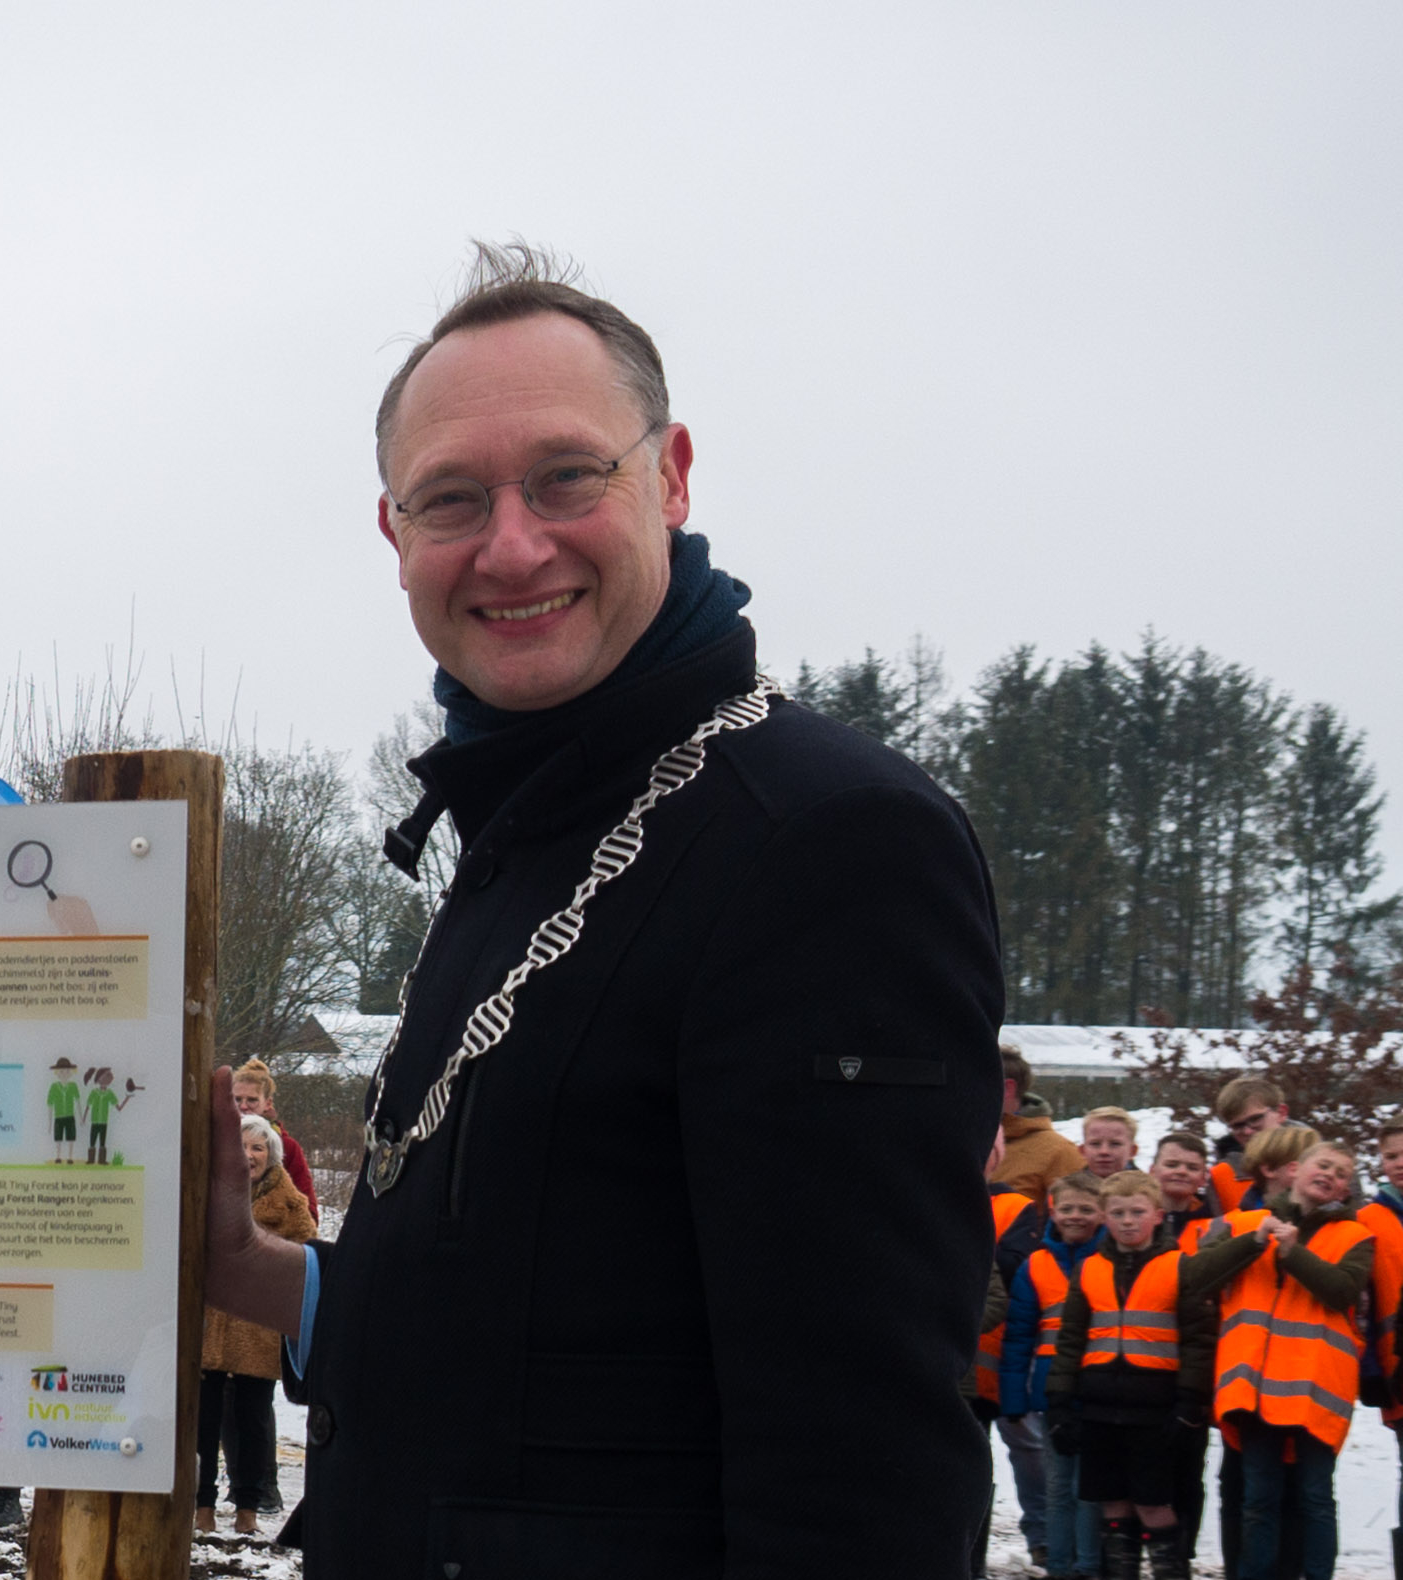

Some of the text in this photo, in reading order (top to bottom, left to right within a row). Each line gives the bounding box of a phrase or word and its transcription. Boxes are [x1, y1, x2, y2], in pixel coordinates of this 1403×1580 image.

[6, 1194, 35, 1203] Forest
[37, 1195, 75, 1206] Rangers
[72, 1373, 125, 1384] HUNEBED
[71, 1383, 126, 1394] CENTRUM
[28, 1397, 70, 1420] ivn
[50, 1437, 143, 1452] VolkerWess
